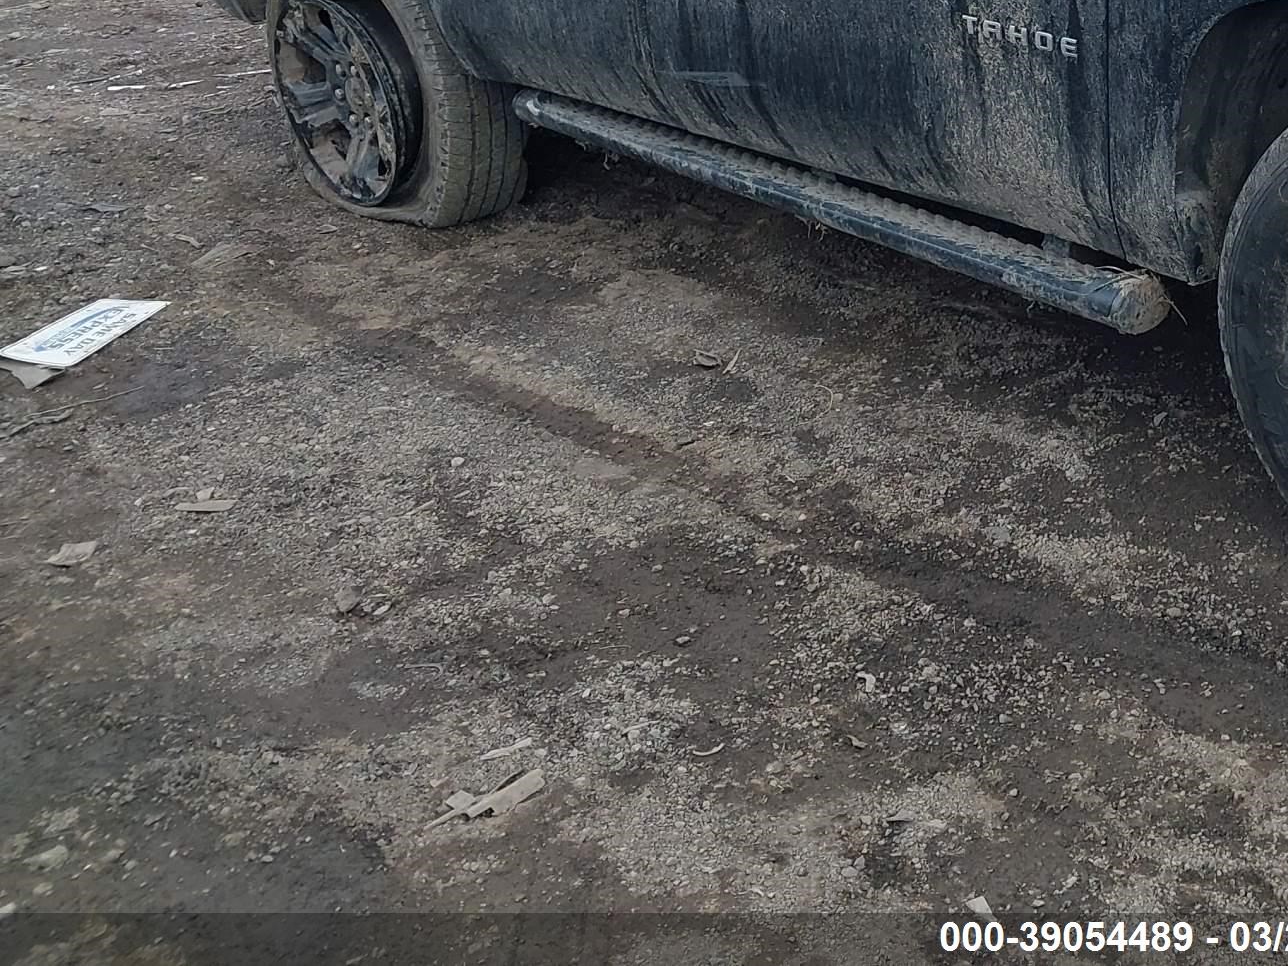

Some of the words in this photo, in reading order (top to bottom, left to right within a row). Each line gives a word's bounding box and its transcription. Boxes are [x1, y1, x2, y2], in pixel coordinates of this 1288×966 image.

[961, 14, 1078, 58] TAHOE
[48, 308, 124, 350] EXPRESS
[93, 313, 137, 338] SAME
[63, 337, 95, 356] DAY
